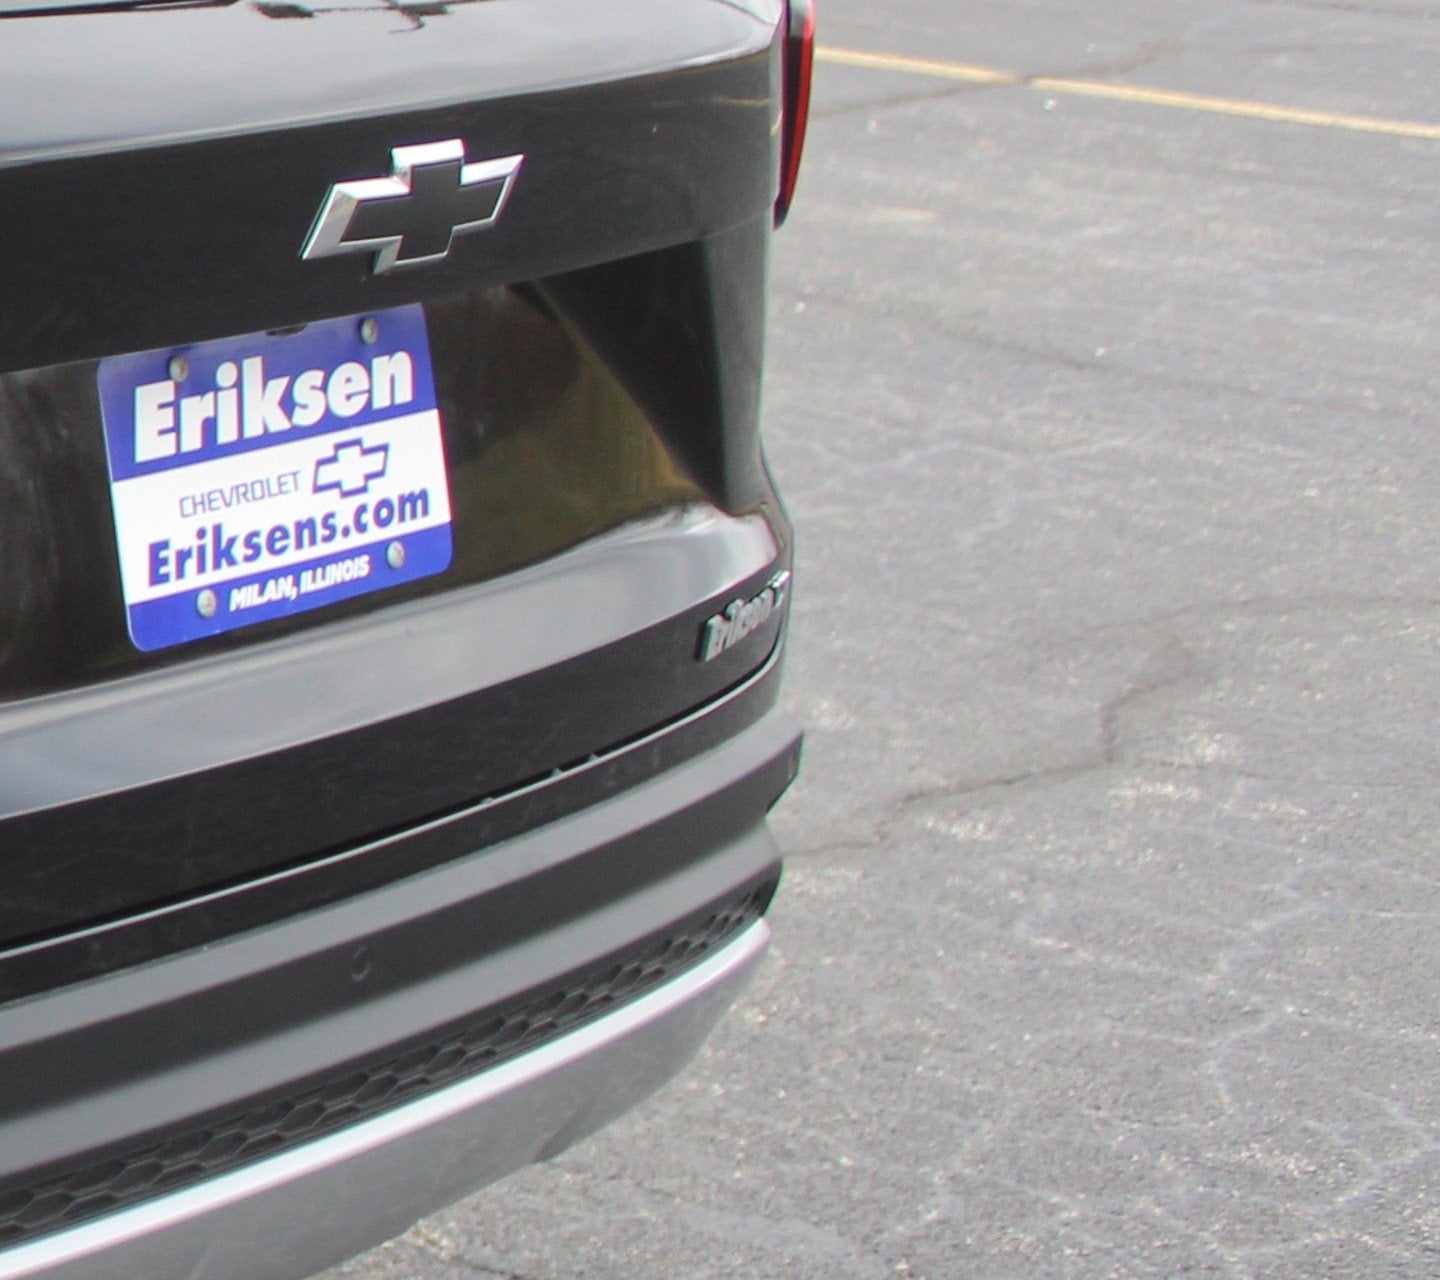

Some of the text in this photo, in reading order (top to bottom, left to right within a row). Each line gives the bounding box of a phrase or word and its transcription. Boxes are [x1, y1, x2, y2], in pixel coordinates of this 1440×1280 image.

[134, 350, 414, 463] Eriksen
[180, 470, 301, 518] CHEVROLET
[148, 487, 431, 587] Eriksens.com
[229, 554, 370, 612] MILAN, ILLINOIS
